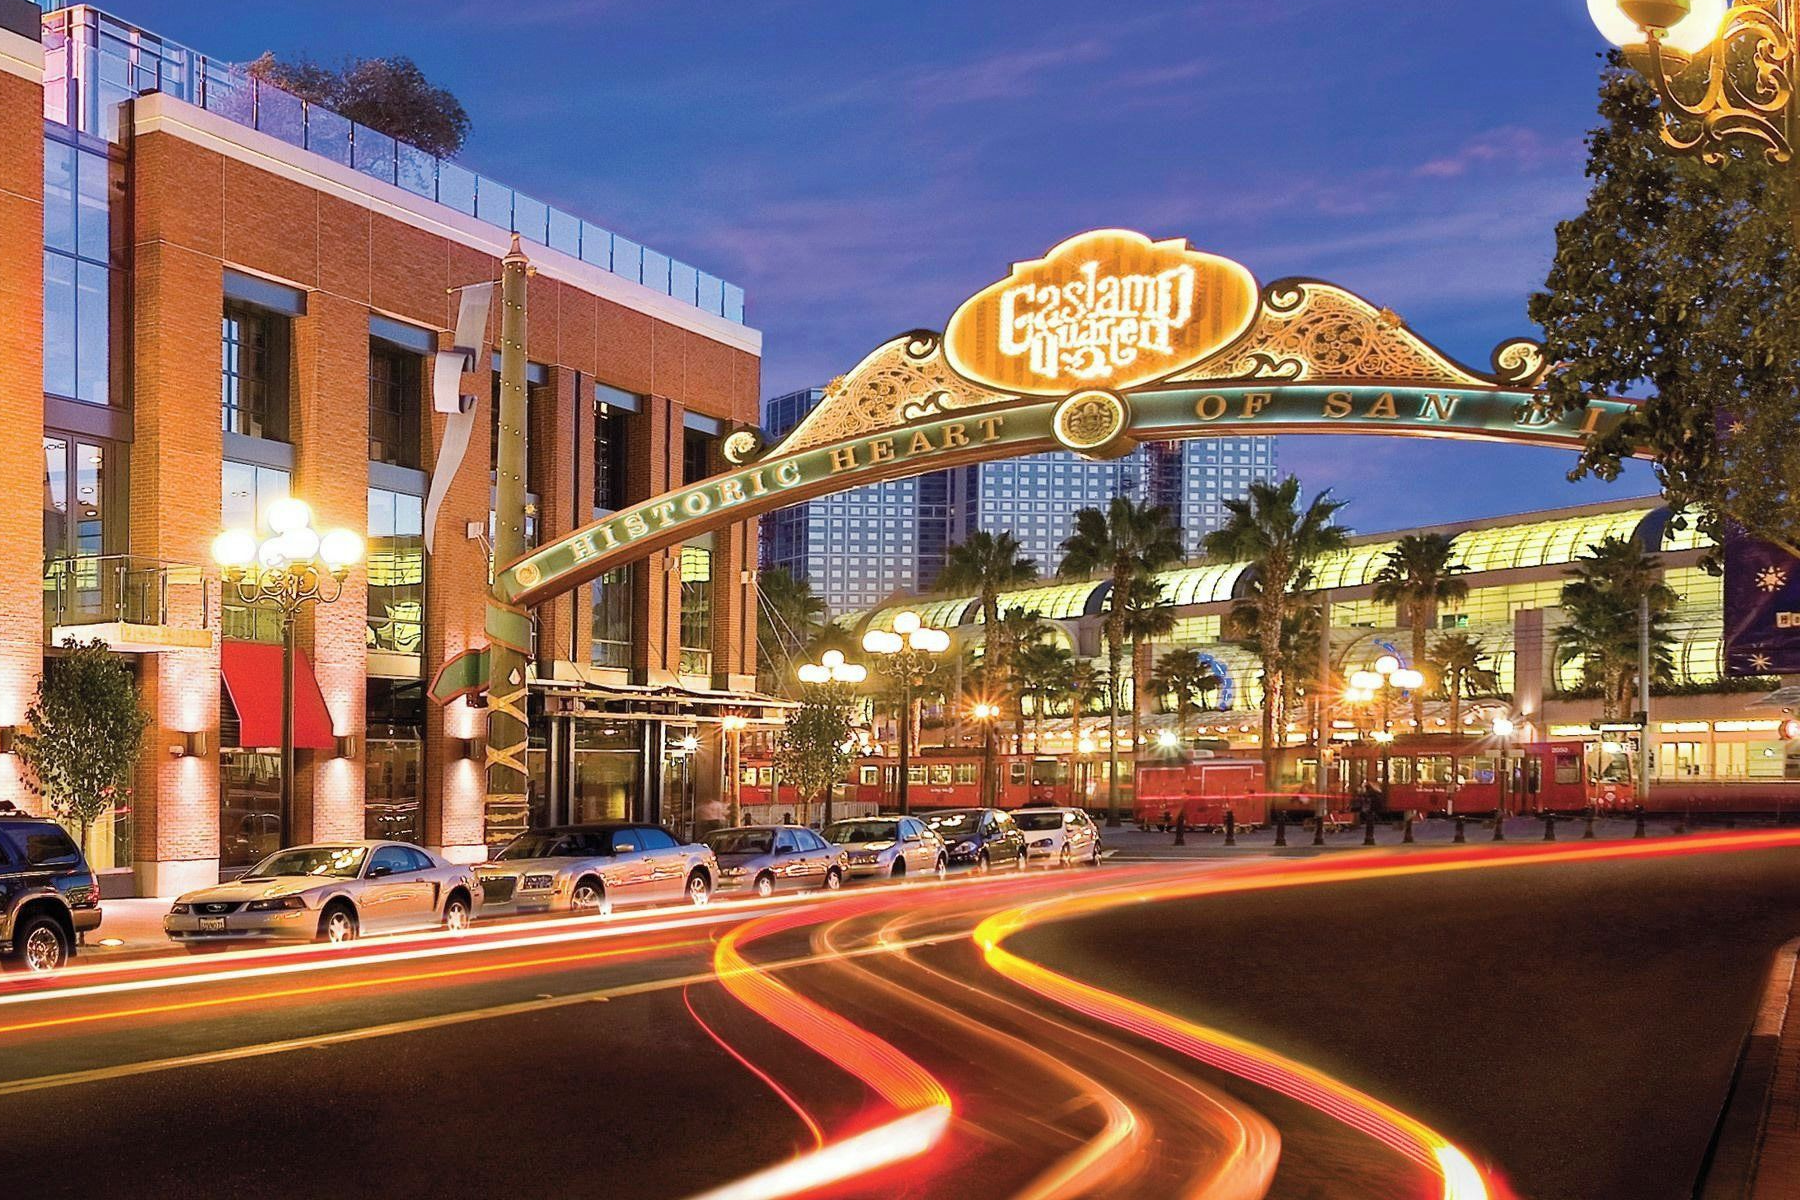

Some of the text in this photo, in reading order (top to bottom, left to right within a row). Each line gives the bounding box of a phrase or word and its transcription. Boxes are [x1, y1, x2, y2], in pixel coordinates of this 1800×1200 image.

[567, 458, 802, 564] HISTORIC
[829, 414, 1006, 473] HEART
[1194, 392, 1272, 422] OF
[1321, 391, 1461, 423] SAN
